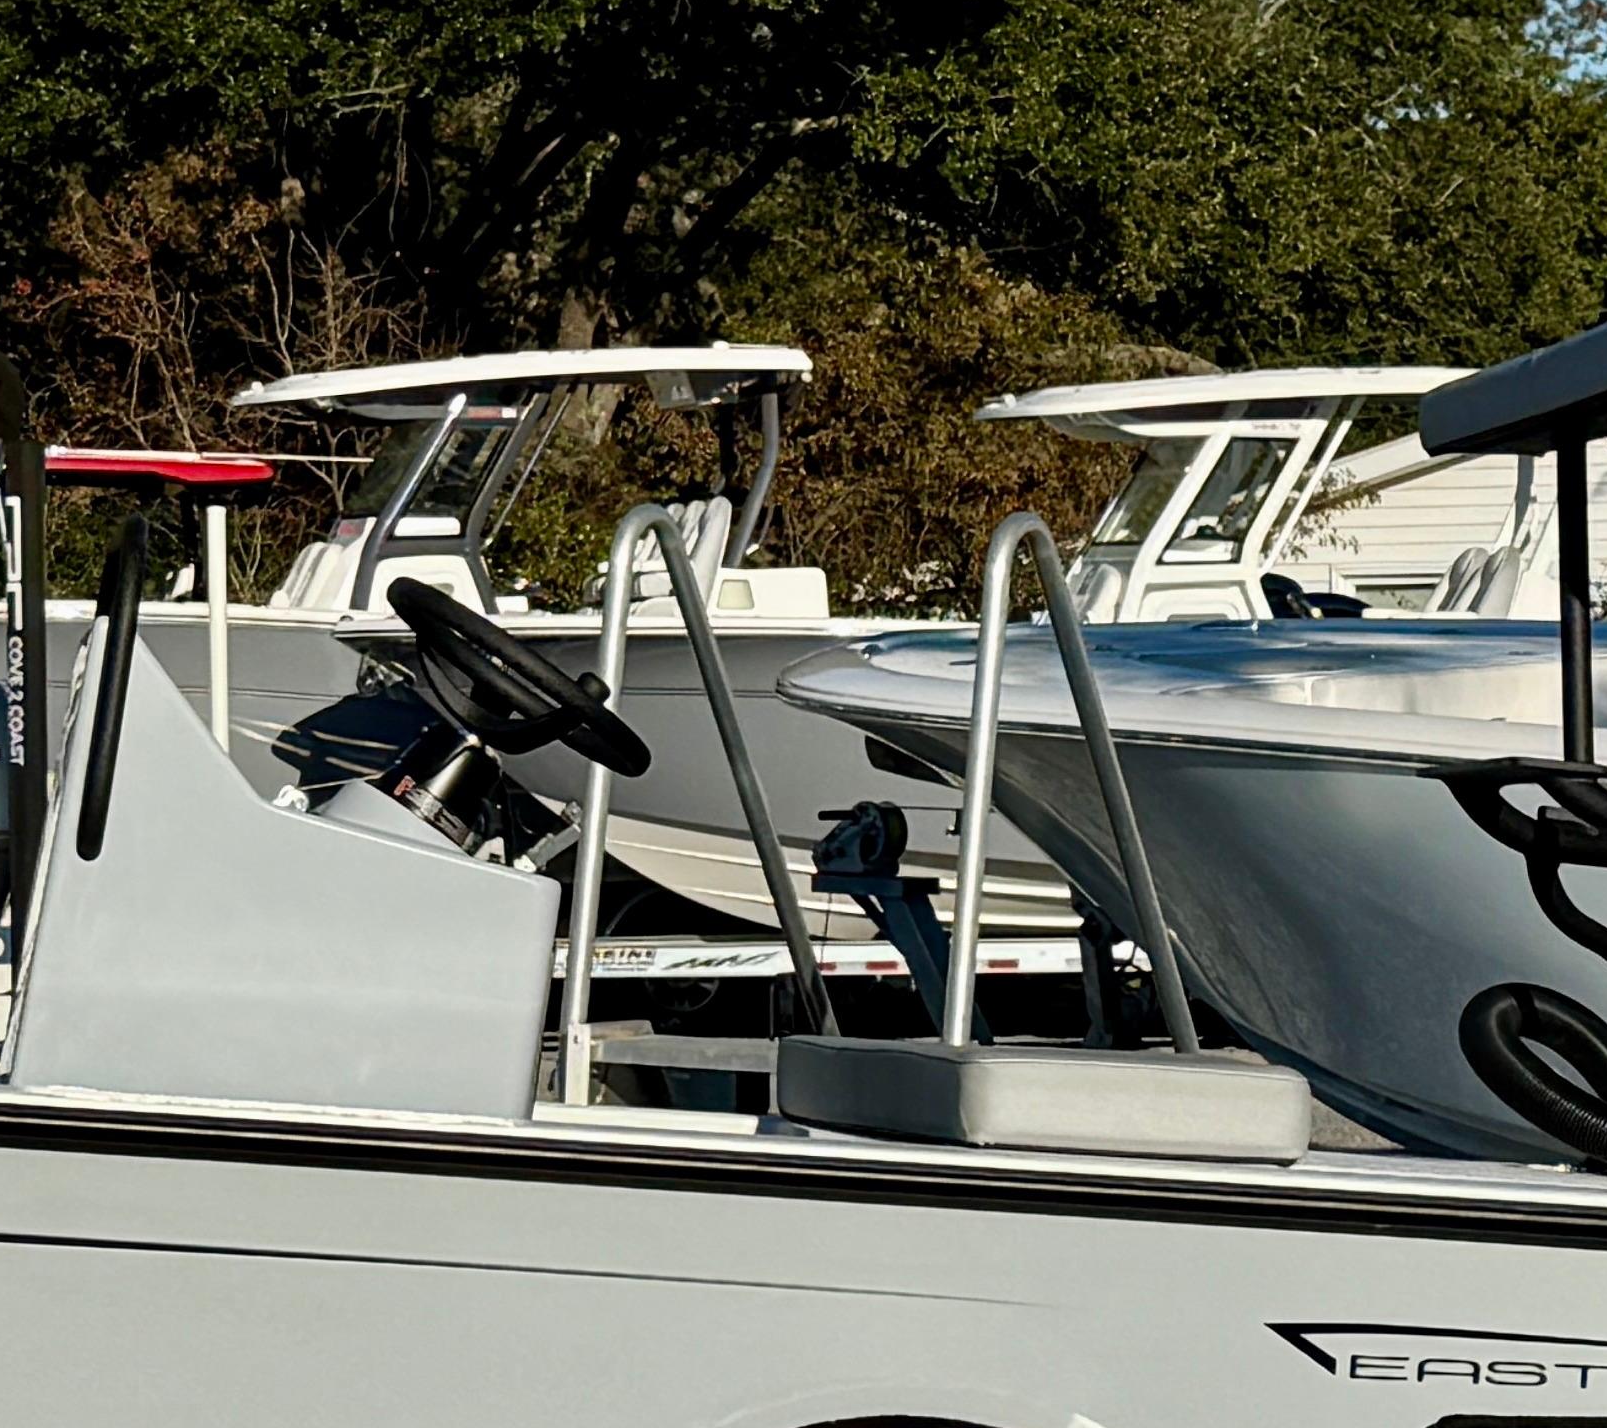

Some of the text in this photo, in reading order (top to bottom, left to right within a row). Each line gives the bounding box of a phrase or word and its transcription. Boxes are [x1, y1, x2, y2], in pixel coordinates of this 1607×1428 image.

[8, 635, 24, 687] COVE
[8, 690, 24, 703] 2
[8, 704, 25, 766] COAST
